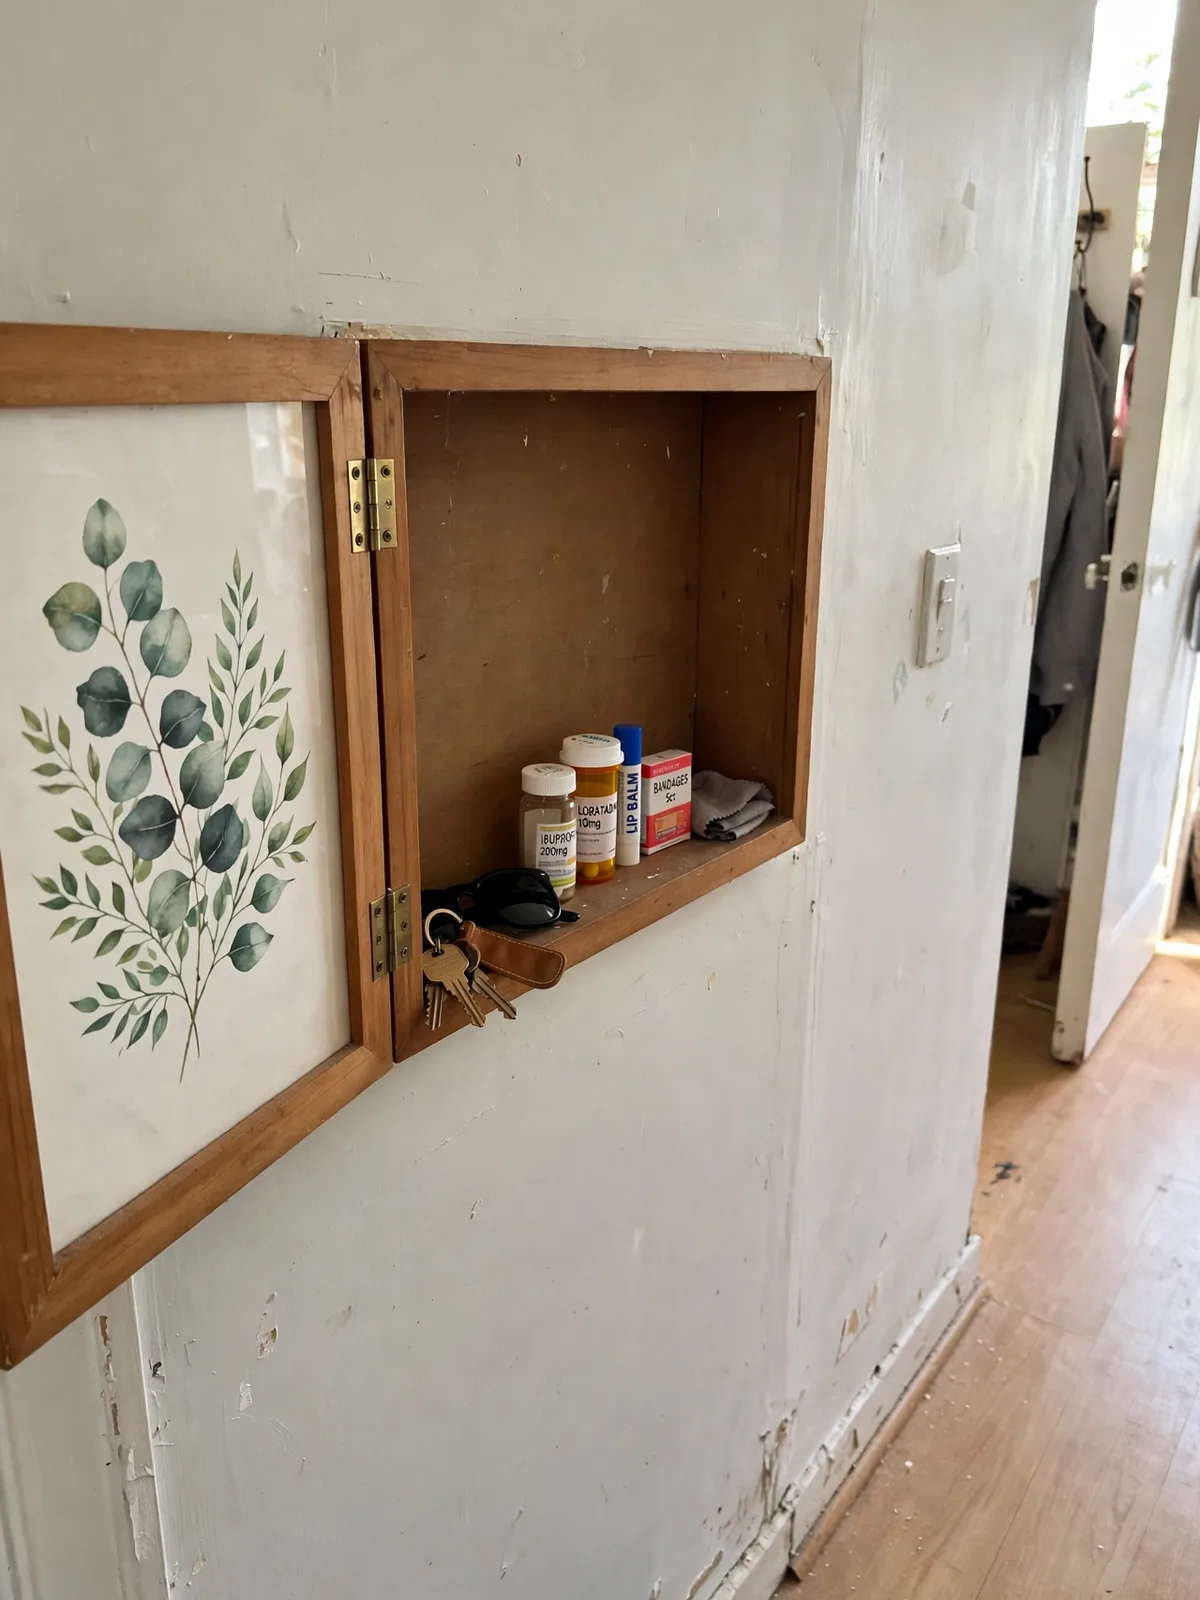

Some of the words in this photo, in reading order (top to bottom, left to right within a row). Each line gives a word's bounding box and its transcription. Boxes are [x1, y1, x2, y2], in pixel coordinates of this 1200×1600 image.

[626, 772, 639, 811] BALM
[653, 773, 689, 794] BANDAGES
[578, 817, 601, 830] 10mg
[626, 814, 638, 834] LIP
[539, 846, 568, 857] 200mg
